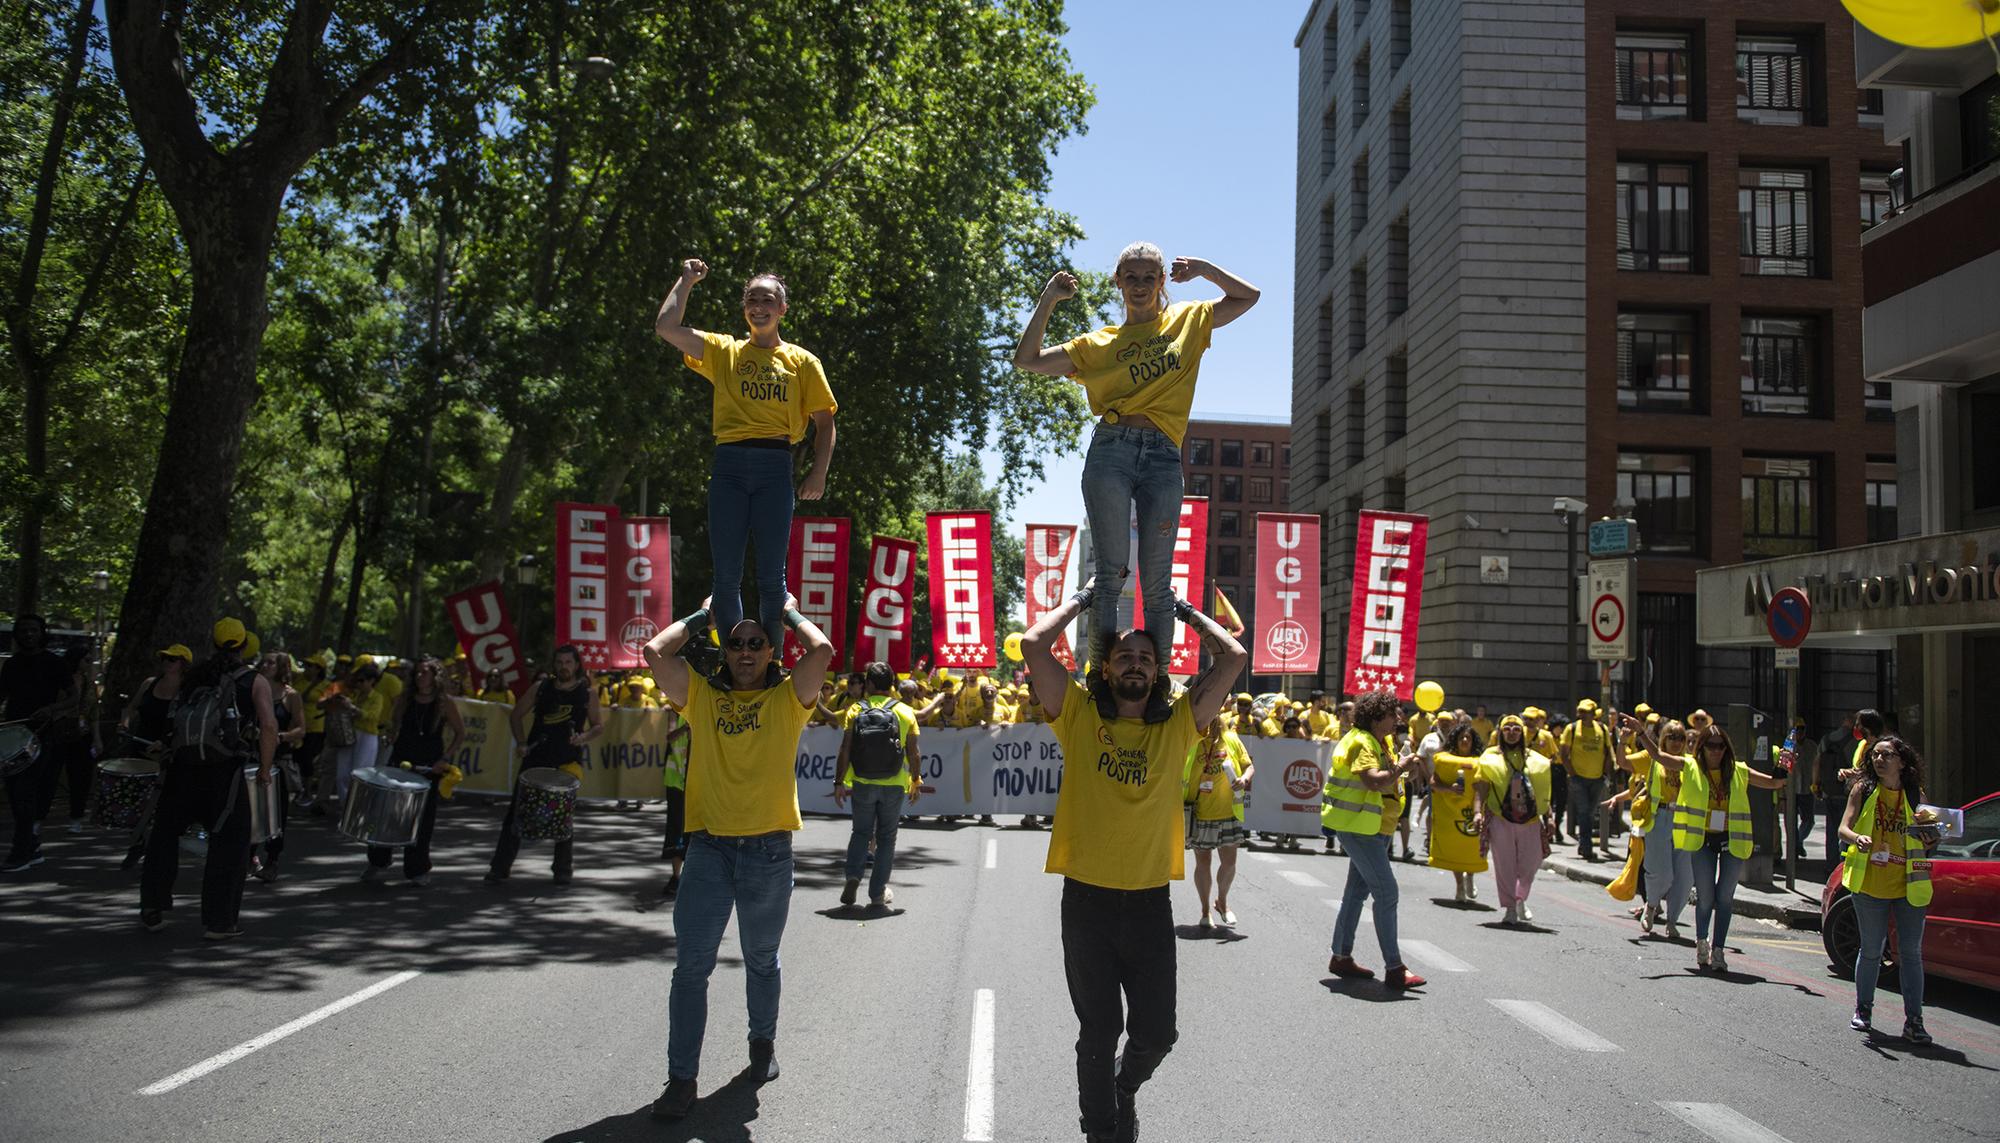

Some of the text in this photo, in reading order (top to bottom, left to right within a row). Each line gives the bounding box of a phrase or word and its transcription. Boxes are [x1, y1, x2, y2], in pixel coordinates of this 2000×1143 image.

[1129, 353, 1182, 384] POSTAL
[741, 380, 788, 403] POSTAL
[570, 509, 606, 641] CCOO
[626, 523, 653, 616] UGT
[941, 517, 981, 644] CCOO
[1032, 528, 1072, 623] UG
[1275, 522, 1302, 618] UGT
[1898, 553, 2000, 607] Mont
[863, 545, 910, 664] UGT
[1361, 519, 1413, 668] CCOO
[1272, 627, 1302, 644] UGT
[1753, 713, 1765, 729] P
[580, 743, 666, 770] A VIABIL
[992, 741, 1032, 761] STOP
[1097, 751, 1147, 787] POSTAL
[1288, 766, 1319, 784] UGT
